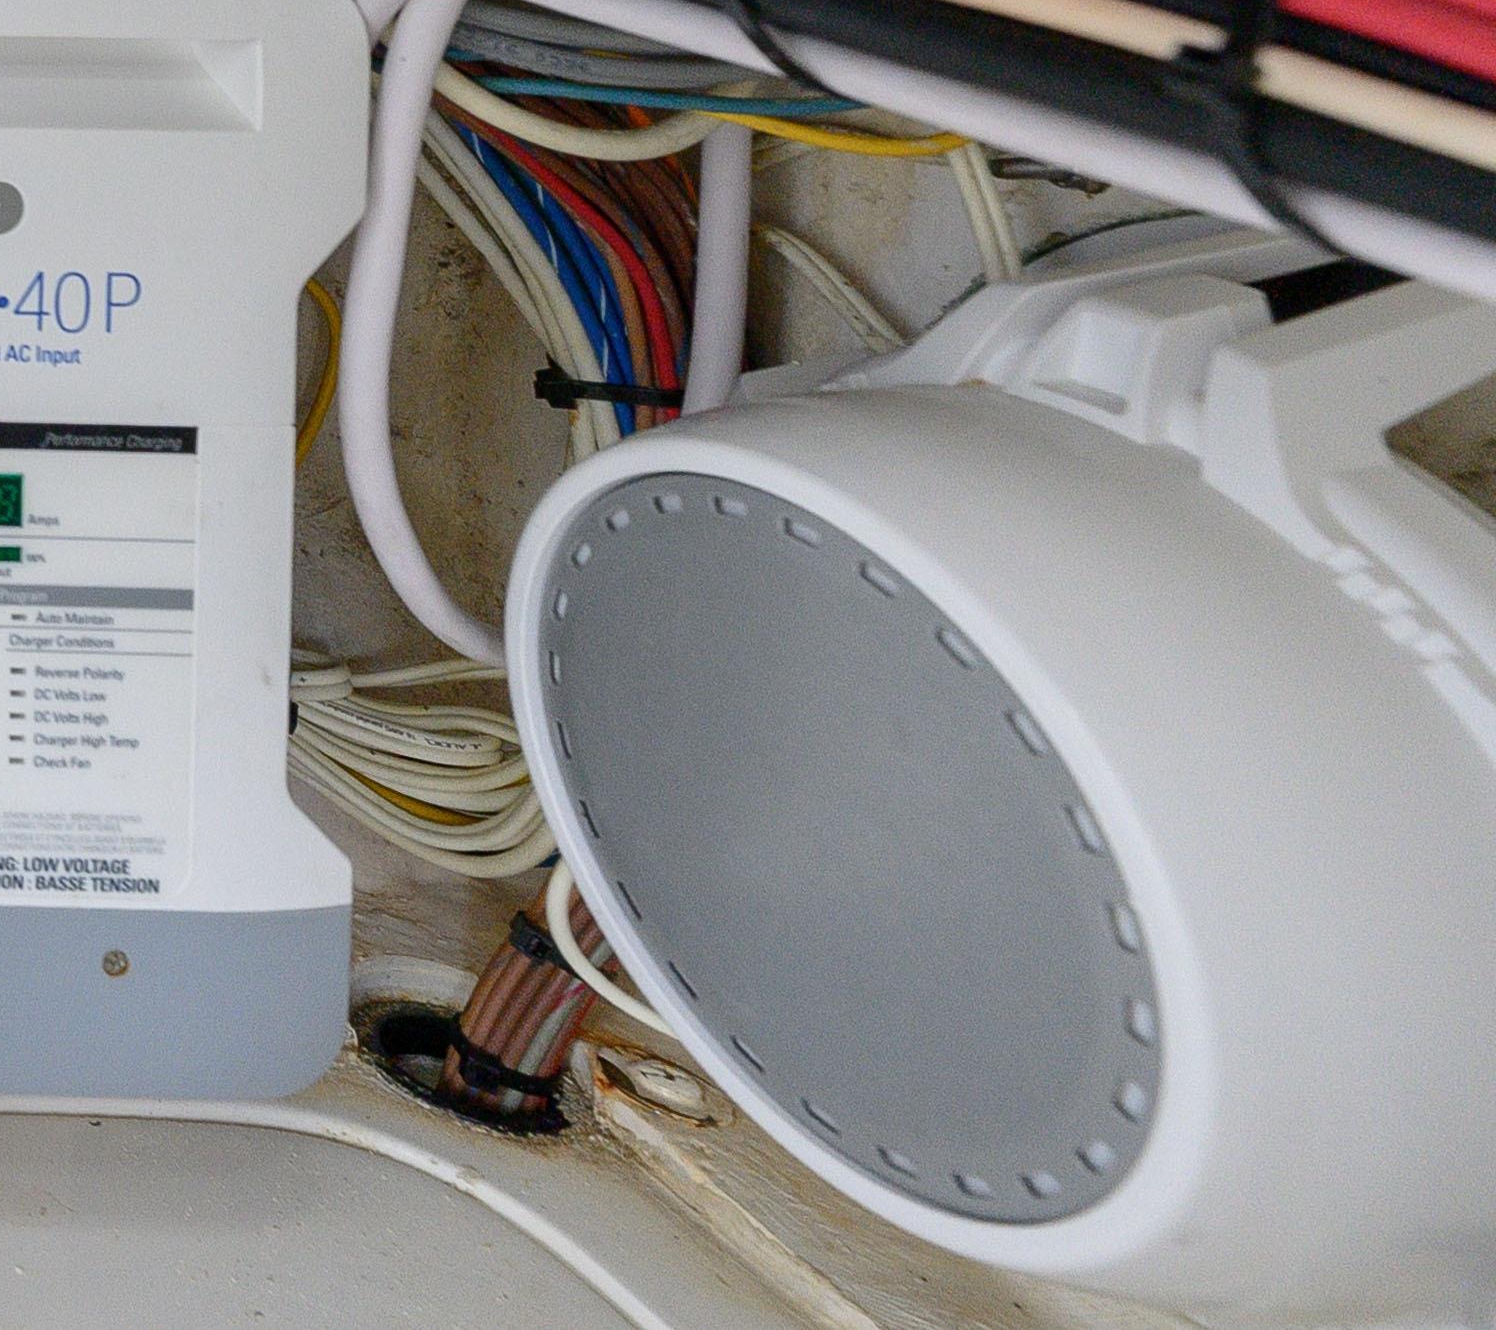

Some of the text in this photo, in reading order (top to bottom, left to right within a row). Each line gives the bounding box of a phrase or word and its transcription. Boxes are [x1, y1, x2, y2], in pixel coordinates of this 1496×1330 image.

[5, 345, 32, 363] AC
[36, 346, 81, 368] Input
[127, 434, 183, 451] Charging
[35, 612, 115, 625] Auto Maintain
[9, 633, 115, 649] Charger Conditions
[34, 666, 80, 679] Reverse
[23, 856, 59, 872] LOW
[63, 858, 130, 875] VOLTAGE
[35, 875, 87, 891] BASSE
[92, 876, 161, 894] TENSION
